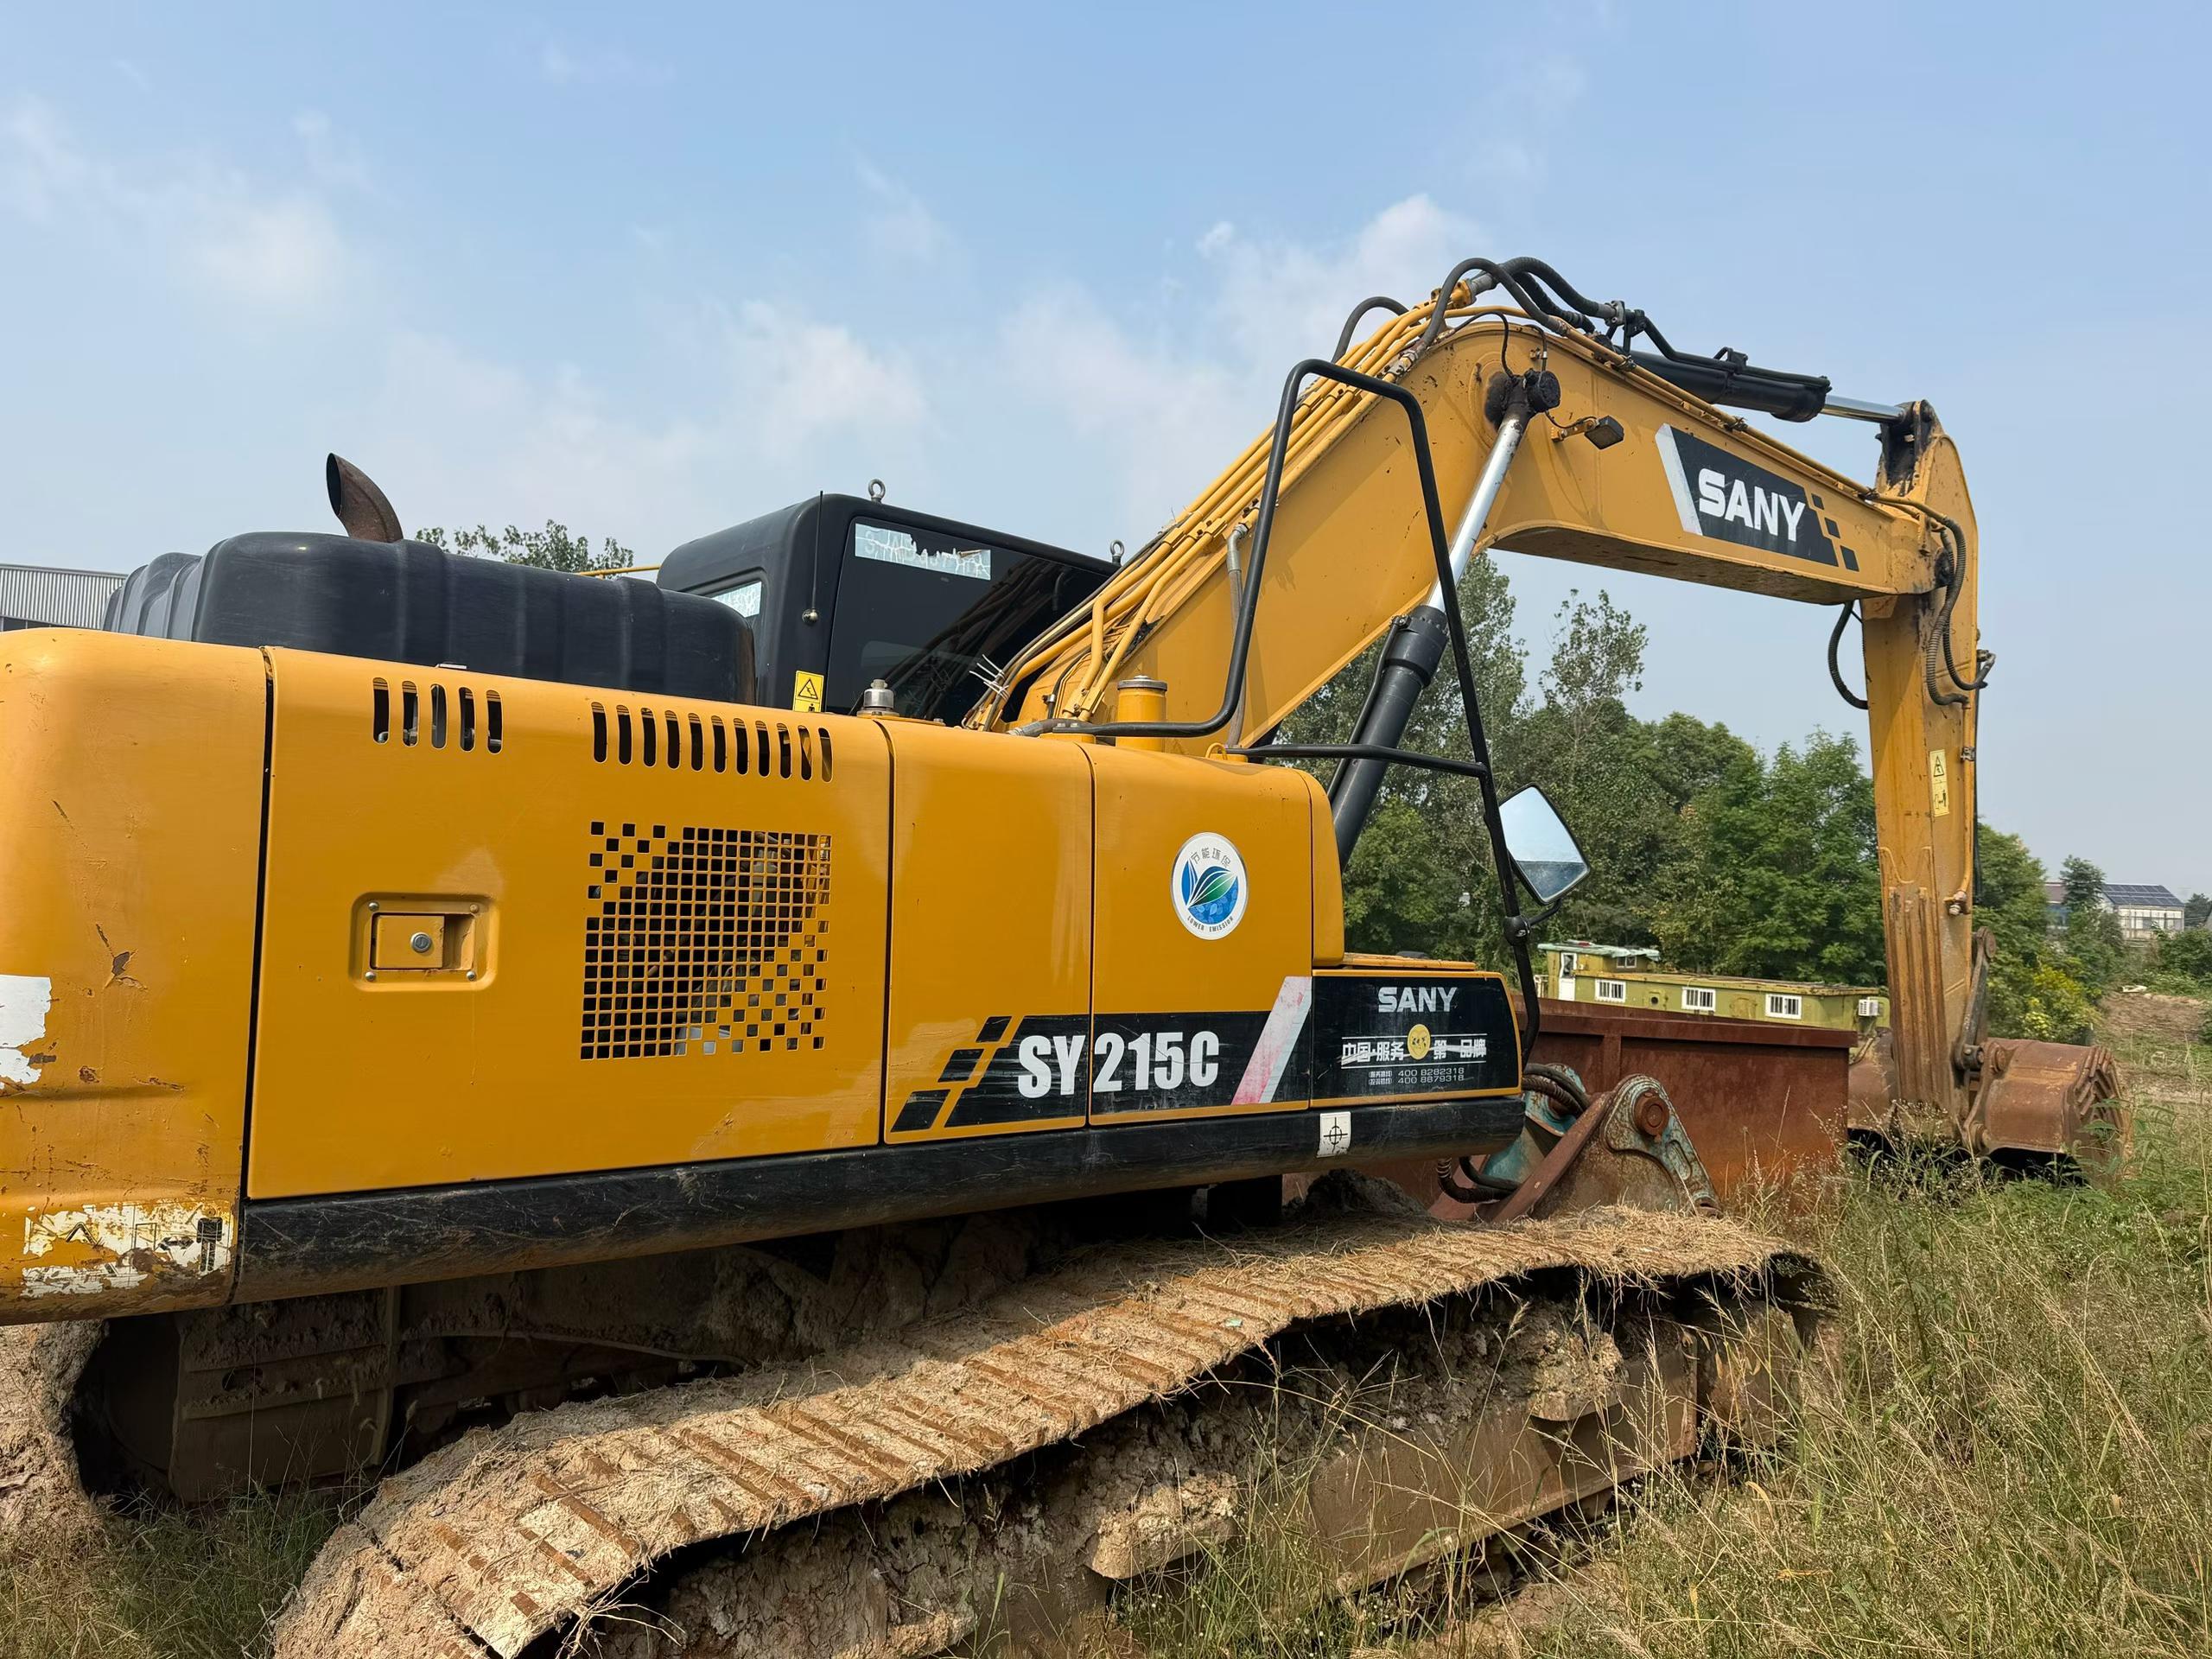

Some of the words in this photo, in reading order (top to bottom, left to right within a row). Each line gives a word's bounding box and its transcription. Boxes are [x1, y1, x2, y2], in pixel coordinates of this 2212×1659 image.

[1699, 468, 1805, 542] SANY
[1187, 916, 1205, 931] LOWER
[1209, 916, 1233, 932] EMISSION
[1378, 987, 1458, 1013] SANY
[1421, 1067, 1465, 1077] 8282318
